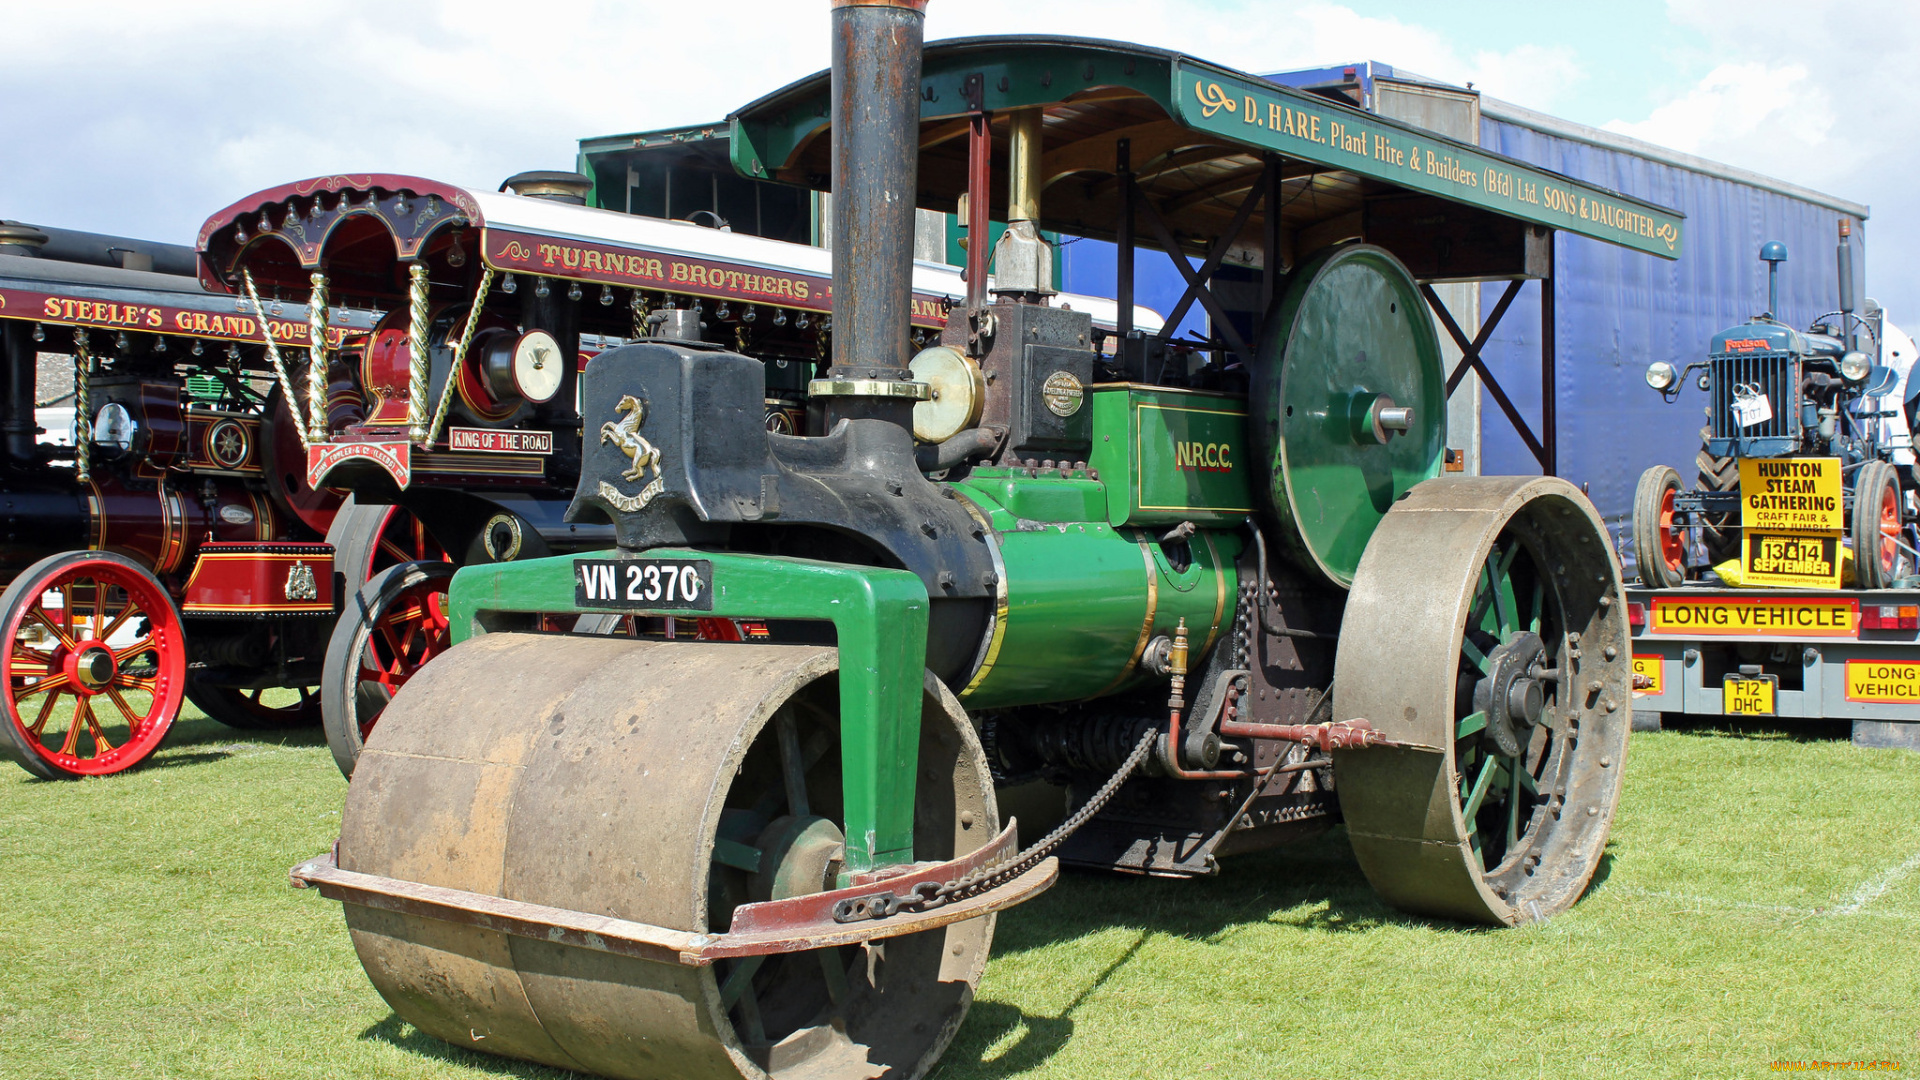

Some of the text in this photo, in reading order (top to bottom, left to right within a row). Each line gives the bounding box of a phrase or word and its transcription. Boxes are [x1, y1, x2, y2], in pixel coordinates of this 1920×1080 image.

[1244, 95, 1655, 239] D. HARE. Plant Hire & Builders (Bfd) Ltd. SONS & DAUGHTER
[537, 243, 664, 280] TURNER
[668, 261, 809, 301] BROTHERS
[45, 296, 163, 328] STEELE'S
[175, 311, 257, 338] GRAND
[268, 321, 307, 340] 20TH
[1725, 339, 1771, 352] Fordson
[455, 431, 549, 450] KING OF THE ROAD
[329, 446, 353, 464] FOWLER
[1177, 441, 1232, 470] N.R.C.C.
[1758, 462, 1822, 477] HUNTON
[1766, 479, 1816, 494] STEAM
[1749, 494, 1835, 511] GATHERING
[1757, 512, 1828, 523] CRAFT FAIR &
[1756, 521, 1832, 534] AUTO JUMBLE
[1764, 543, 1819, 562] 13 & 14
[1753, 557, 1831, 575] SEPTEMBER
[581, 565, 699, 602] VN 2370
[1661, 606, 1846, 627] LONG VEHICLE
[1868, 667, 1915, 680] LONG
[1736, 682, 1760, 696] F12
[1855, 683, 1920, 697] VEHICL
[1734, 698, 1762, 712] DHC
